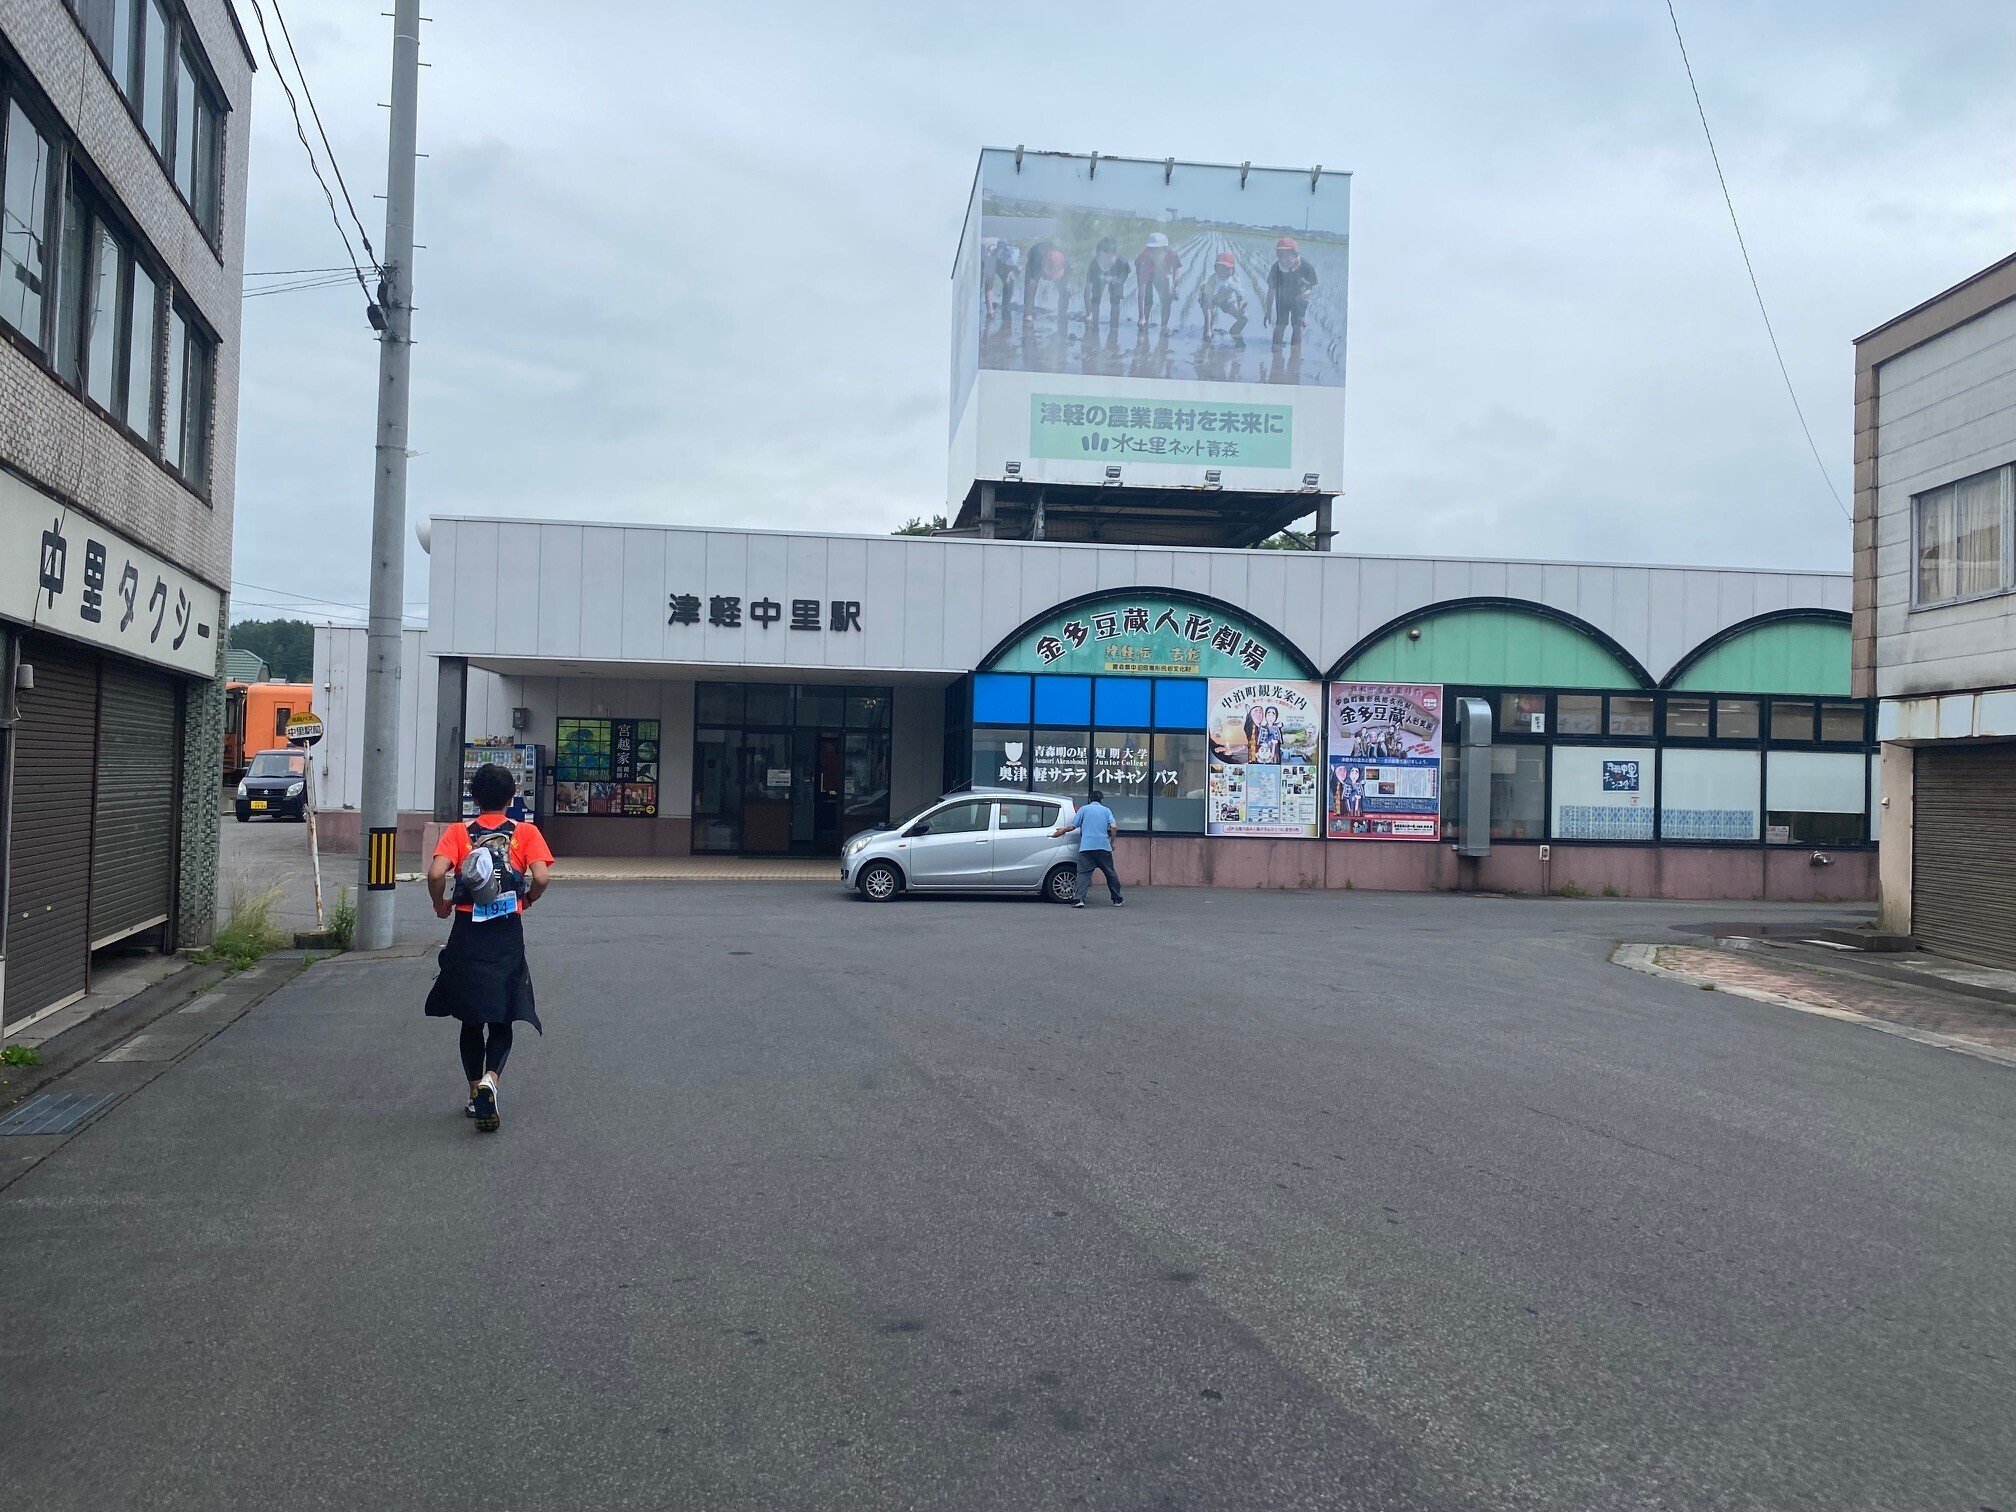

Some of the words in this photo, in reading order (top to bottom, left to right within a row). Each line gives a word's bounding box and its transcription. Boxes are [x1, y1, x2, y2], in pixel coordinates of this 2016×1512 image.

[1040, 402, 1284, 434] 津軽の農業農村を未来に
[1112, 433, 1240, 458] 水土里ネット青森
[40, 518, 210, 650] 中里タクシー
[668, 593, 861, 631] 津軽中里駅
[1036, 606, 1270, 673] 金多豆蔵人形劇場
[1221, 684, 1307, 710] 中泊町観光案内
[1340, 704, 1406, 727] 金多豆蔵
[616, 724, 631, 765] 宮越家
[1121, 759, 1147, 767] College
